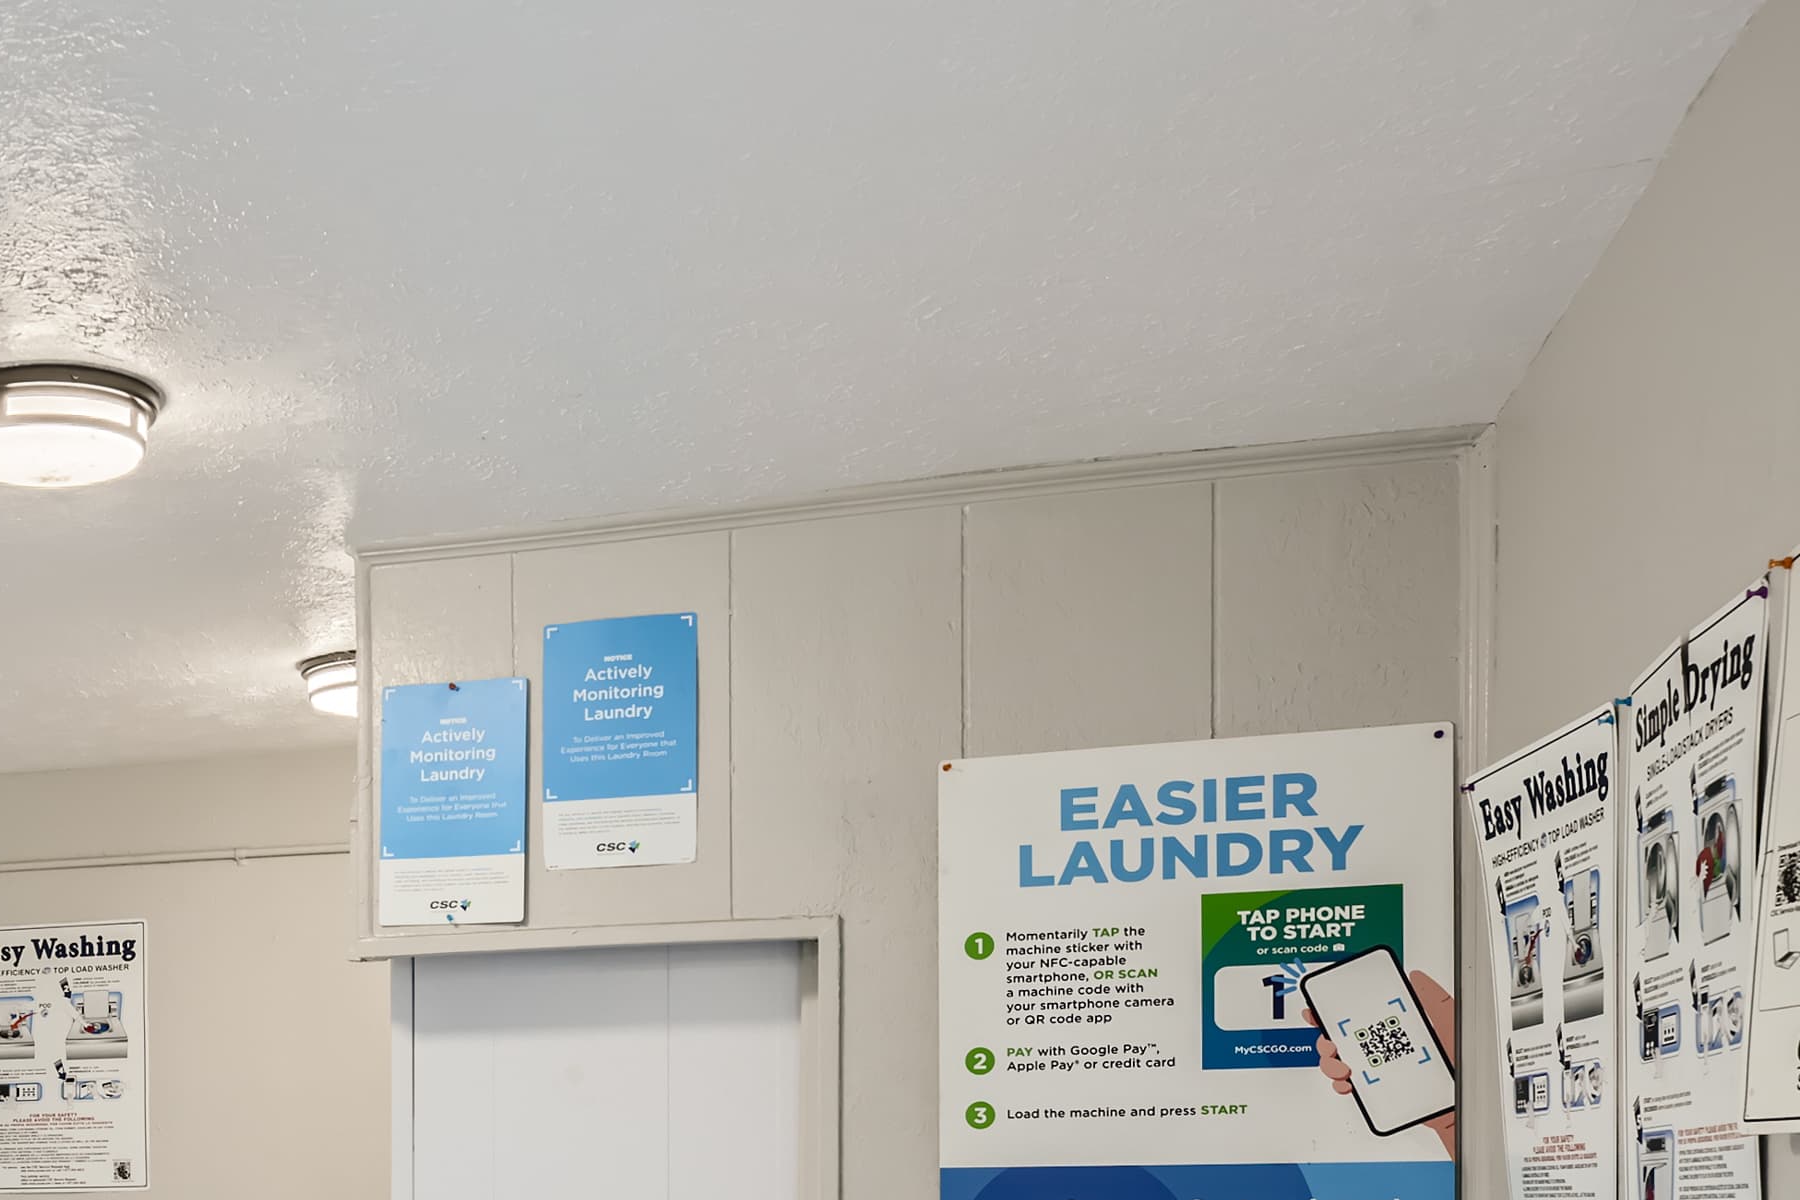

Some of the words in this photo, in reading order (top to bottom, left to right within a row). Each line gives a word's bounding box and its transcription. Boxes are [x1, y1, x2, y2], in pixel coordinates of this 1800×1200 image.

[584, 664, 653, 682] Actively
[573, 684, 664, 702] Monitoring
[1635, 678, 1680, 752] Simple
[1683, 634, 1755, 714] Drying
[584, 704, 653, 721] Laundry
[421, 727, 486, 744] Actively
[410, 747, 496, 764] Monitoring
[420, 766, 485, 782] Laundry
[1060, 773, 1318, 831] EASIER
[1479, 795, 1522, 841] Easy
[1523, 752, 1609, 819] Washing
[596, 842, 626, 852] CSC
[1019, 825, 1364, 888] LAUNDRY
[430, 900, 458, 910] CSC
[1237, 909, 1280, 925] TAP
[1286, 905, 1366, 923] PHONE
[1006, 929, 1088, 941] Momentarily
[1092, 928, 1120, 938] TAP
[1124, 926, 1146, 936] the
[1246, 926, 1277, 941] TO
[1283, 922, 1356, 940] START
[31, 935, 136, 962] Washing
[1006, 944, 1061, 956] machine
[1065, 942, 1110, 953] sticker
[1114, 941, 1143, 951] with
[1256, 947, 1269, 955] or
[1272, 946, 1298, 954] scan
[1300, 944, 1329, 954] code
[71, 965, 93, 973] LOAD
[95, 963, 129, 972] WASHER
[1006, 960, 1036, 971] your
[1040, 956, 1127, 968] NFC-capable
[1006, 972, 1090, 984] smartphone,
[1093, 970, 1114, 980] OR
[1118, 968, 1158, 979] SCAN
[1006, 989, 1014, 998] a
[1018, 986, 1073, 997] machine
[1077, 984, 1111, 995] code
[1115, 983, 1144, 993] with
[1262, 974, 1285, 1020] 1
[1006, 1002, 1036, 1013] your
[1040, 998, 1120, 1012] smartphone
[1124, 997, 1175, 1008] camera
[1006, 1016, 1020, 1025] or
[1024, 1015, 1045, 1025] QR
[1049, 1013, 1082, 1024] code
[1086, 1013, 1112, 1024] app
[1006, 1047, 1033, 1057] PAY
[1037, 1046, 1066, 1057] with
[1070, 1044, 1119, 1058] Google
[1235, 1044, 1312, 1055] MyCSCGO.com
[1007, 1060, 1046, 1073] Apple
[1083, 1061, 1098, 1070] or
[1102, 1058, 1142, 1070] credit
[1145, 1057, 1176, 1068] card
[1007, 1109, 1040, 1120] Load
[1043, 1108, 1065, 1119] the
[1069, 1107, 1126, 1118] machine
[1130, 1106, 1155, 1117] and
[1160, 1106, 1196, 1118] press
[1200, 1104, 1248, 1115] START
